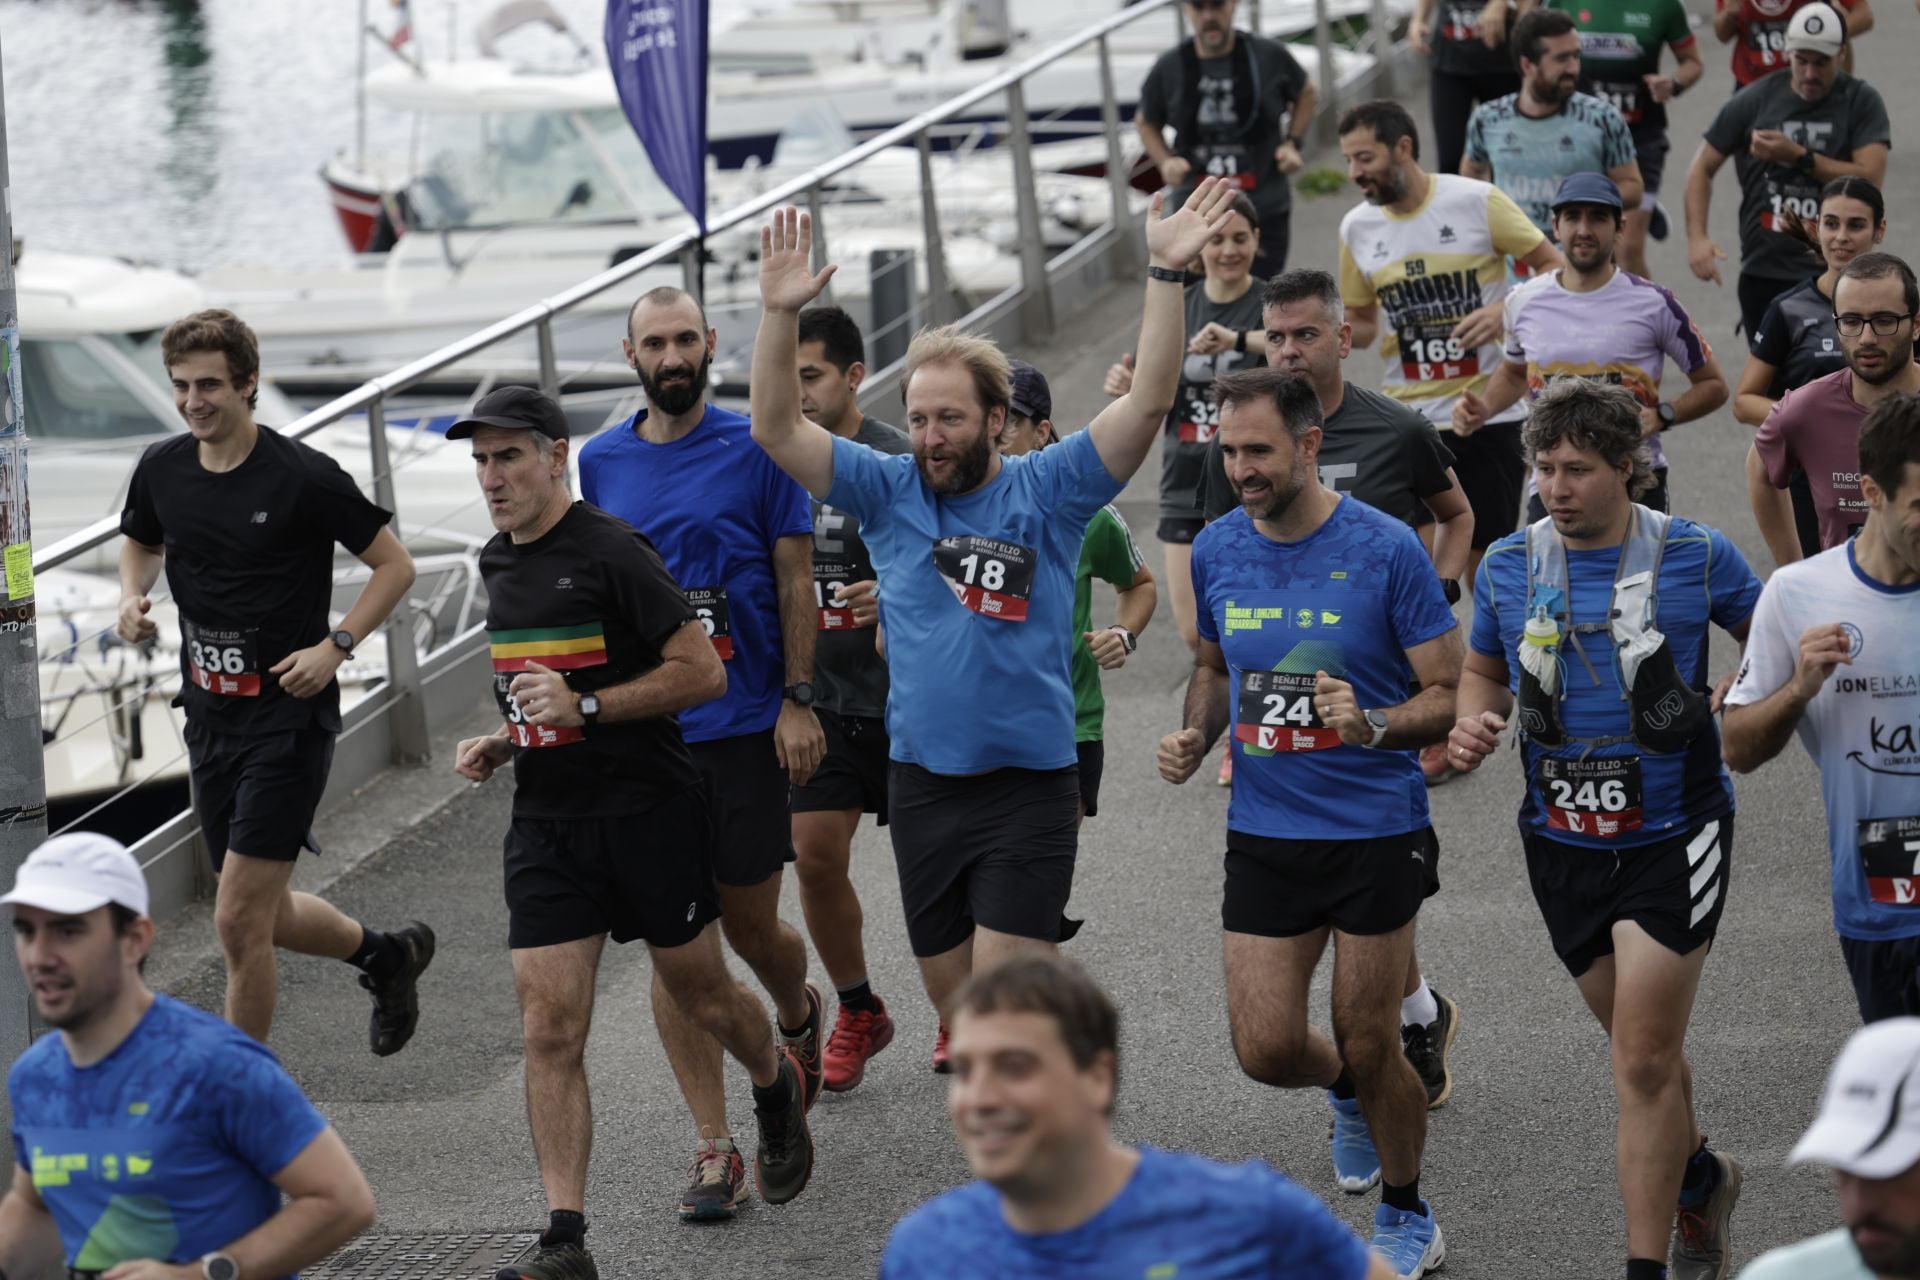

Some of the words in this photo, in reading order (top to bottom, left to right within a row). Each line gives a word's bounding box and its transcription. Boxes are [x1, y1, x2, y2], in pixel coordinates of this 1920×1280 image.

[1404, 259, 1426, 277] 59
[1410, 336, 1465, 363] 169
[998, 543, 1021, 557] ELZO
[959, 554, 1006, 591] 18
[689, 590, 711, 600] ELZO
[219, 631, 240, 639] ELZO
[191, 640, 245, 674] 336
[1272, 674, 1300, 685] BEÑAT
[1301, 677, 1317, 686] ELZ
[1835, 675, 1920, 693] JONELKA
[506, 693, 532, 723] 3
[1261, 694, 1313, 727] 24
[1597, 760, 1621, 770] ELZO
[1550, 779, 1627, 812] 246
